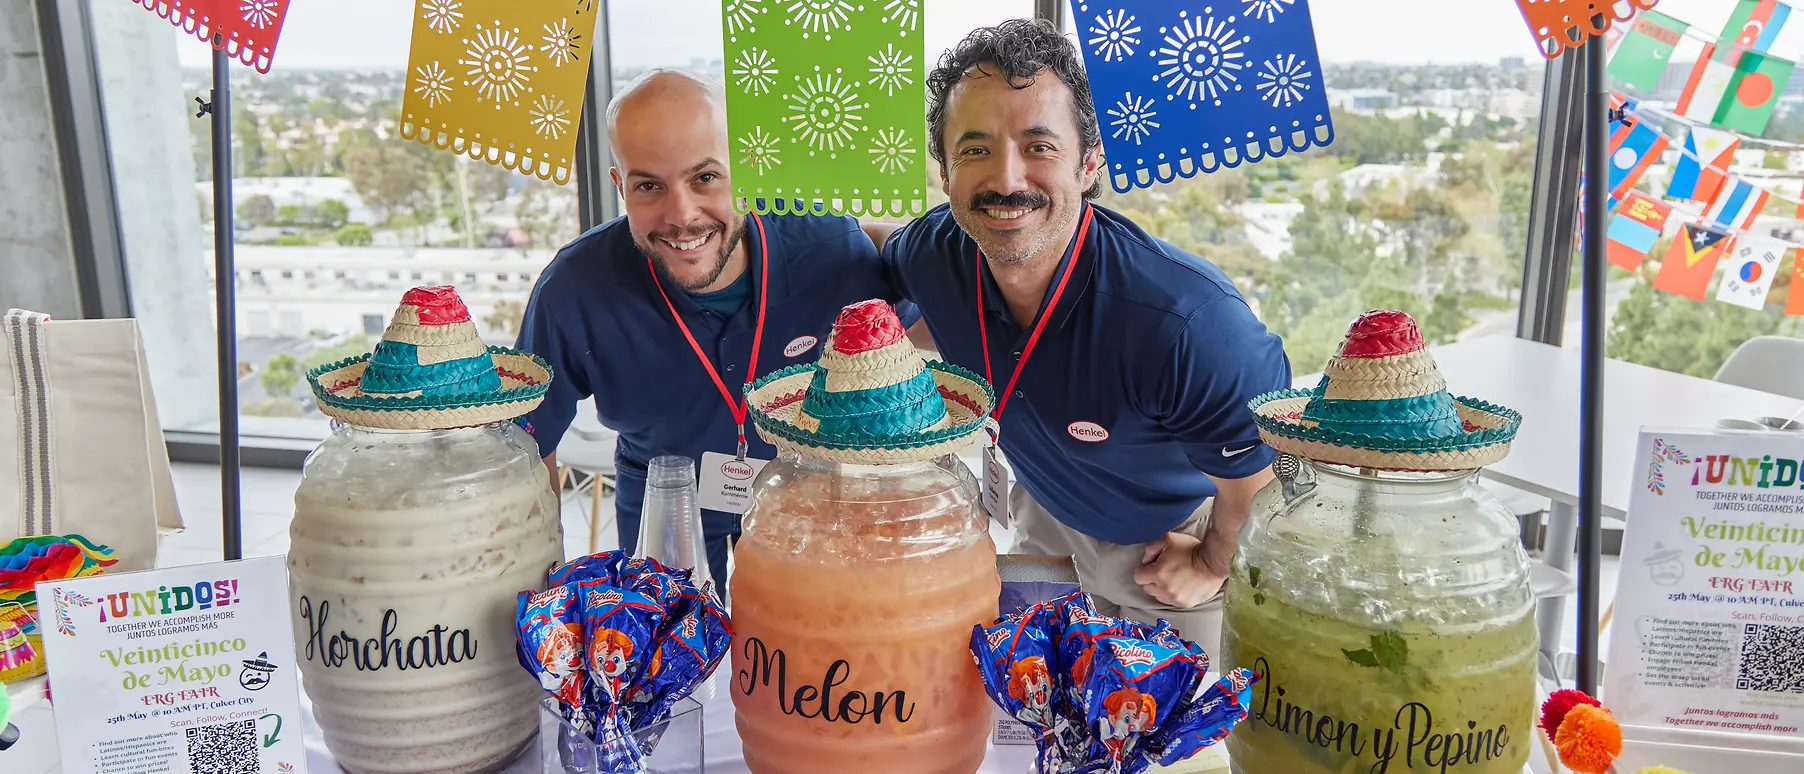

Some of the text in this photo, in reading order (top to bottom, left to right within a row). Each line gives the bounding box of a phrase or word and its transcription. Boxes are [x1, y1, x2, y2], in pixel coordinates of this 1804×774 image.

[786, 338, 815, 355] Henkel
[1070, 426, 1106, 437] Henkel
[724, 466, 751, 476] Henkel
[724, 484, 747, 492] Gerhard
[1696, 491, 1804, 505] TOGETHER WE ACCOMPLIS
[1714, 502, 1745, 512] JUNTOS
[1747, 504, 1793, 514] LOGRAMOS
[1680, 516, 1804, 545] Veinticin
[1695, 544, 1726, 567] de
[1708, 577, 1793, 595] ERG FAIR
[1668, 592, 1687, 601] 25th
[1688, 592, 1710, 603] May
[1715, 595, 1725, 603] @
[1739, 596, 1759, 605] AM
[1780, 599, 1804, 607] Culve
[108, 611, 235, 634] TOGETHER WE ACCOMPLISH MORE
[1732, 612, 1757, 621] Scan,
[1760, 612, 1794, 623] Follow,
[126, 622, 218, 640] JUNTOS LOGRAMOS MÁS
[300, 596, 477, 671] Horchata
[100, 638, 246, 668] Veinticinco
[1110, 642, 1152, 659] Ricolino
[122, 660, 231, 691] de Mayo
[740, 637, 915, 724] Melon
[141, 686, 220, 706] ERG FAIR
[107, 714, 126, 724] 25th
[127, 712, 148, 721] May
[174, 706, 191, 714] AM
[210, 700, 236, 710] Culver
[238, 697, 255, 707] City
[171, 708, 268, 728] Scan, Follow, Connect!
[1254, 657, 1510, 774] Limon y Pepino
[1684, 707, 1779, 720] Juntos logramos más
[1665, 716, 1707, 726] Together
[1721, 722, 1772, 731] accomplish
[100, 741, 156, 754] Latinos/Hispanics
[120, 750, 146, 758] cultural
[102, 758, 136, 767] Participate
[102, 766, 126, 774] Chance
[148, 766, 170, 774] Henkel
